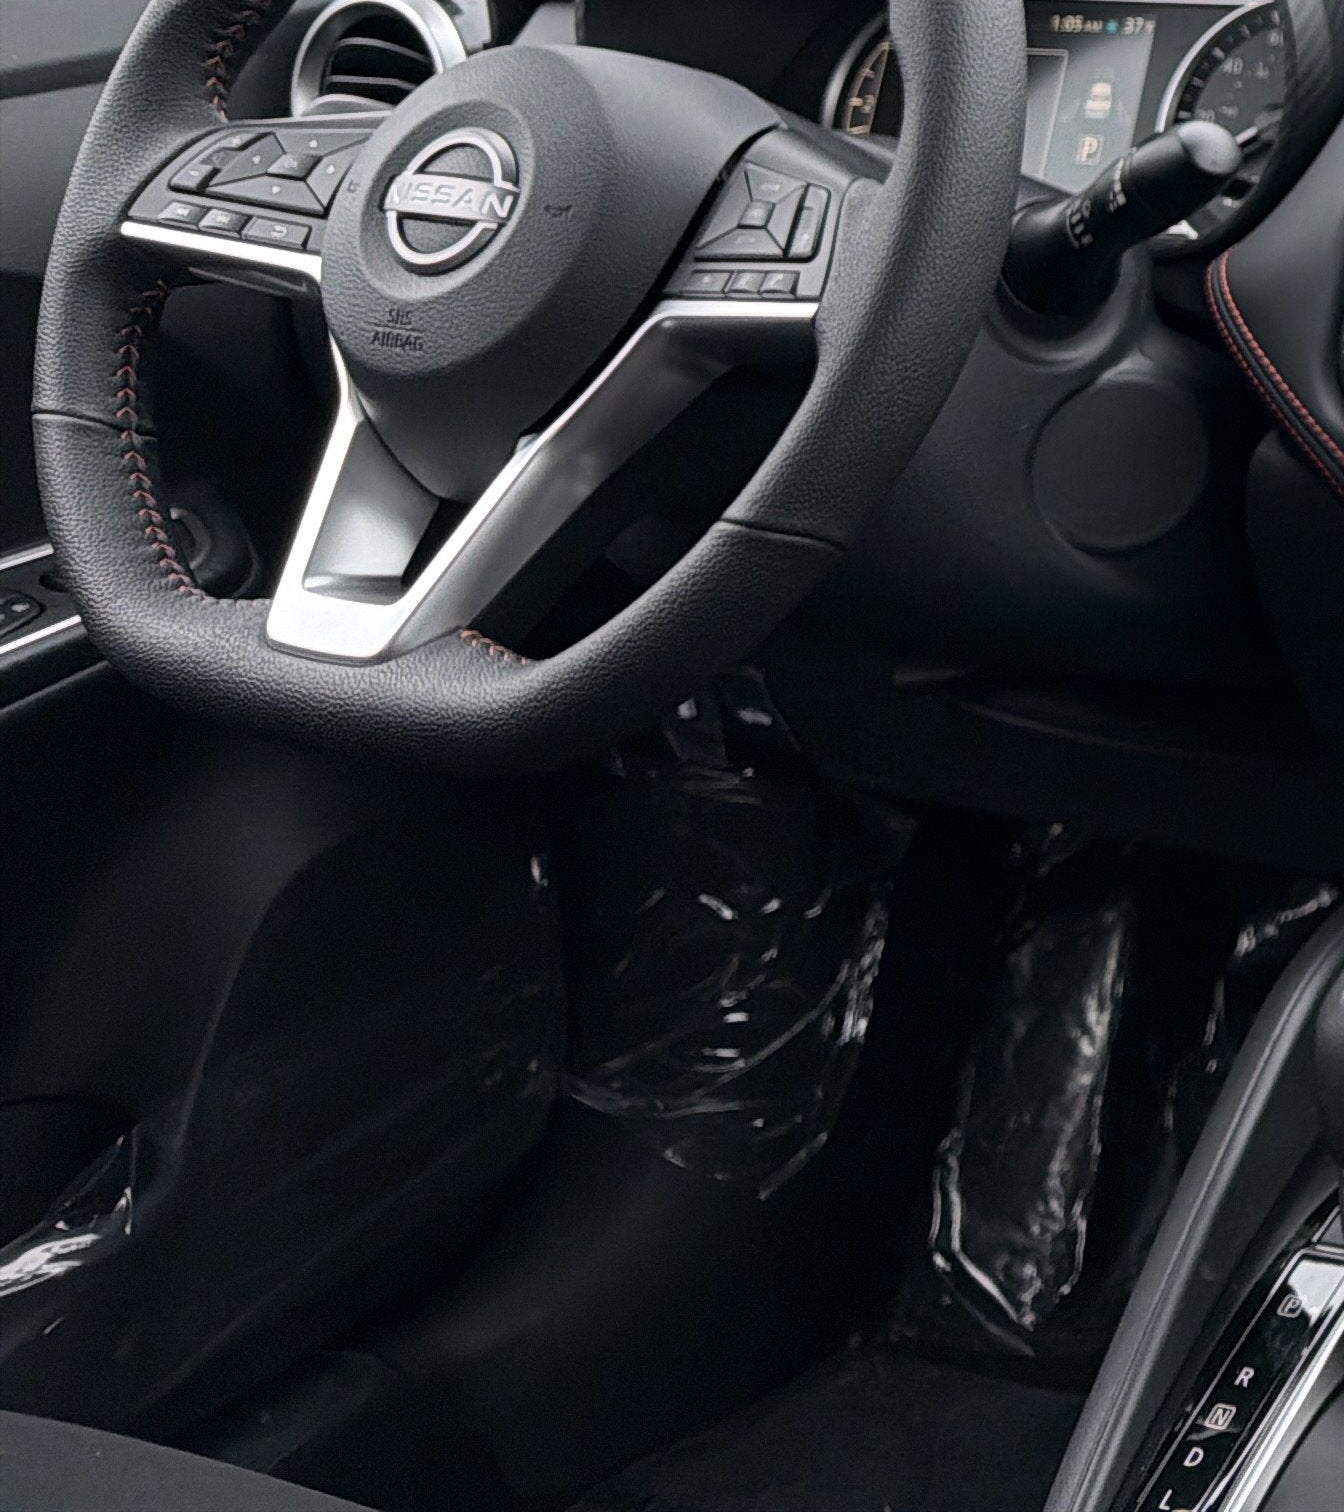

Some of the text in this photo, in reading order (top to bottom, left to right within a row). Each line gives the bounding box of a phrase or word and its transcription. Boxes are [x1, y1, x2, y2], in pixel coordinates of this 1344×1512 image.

[1082, 137, 1098, 162] P
[389, 181, 514, 218] NISSAN
[1284, 1297, 1300, 1315] P
[1234, 1366, 1255, 1388] R
[1211, 1408, 1229, 1425] N
[1183, 1446, 1204, 1467] D
[1159, 1489, 1173, 1511] L
